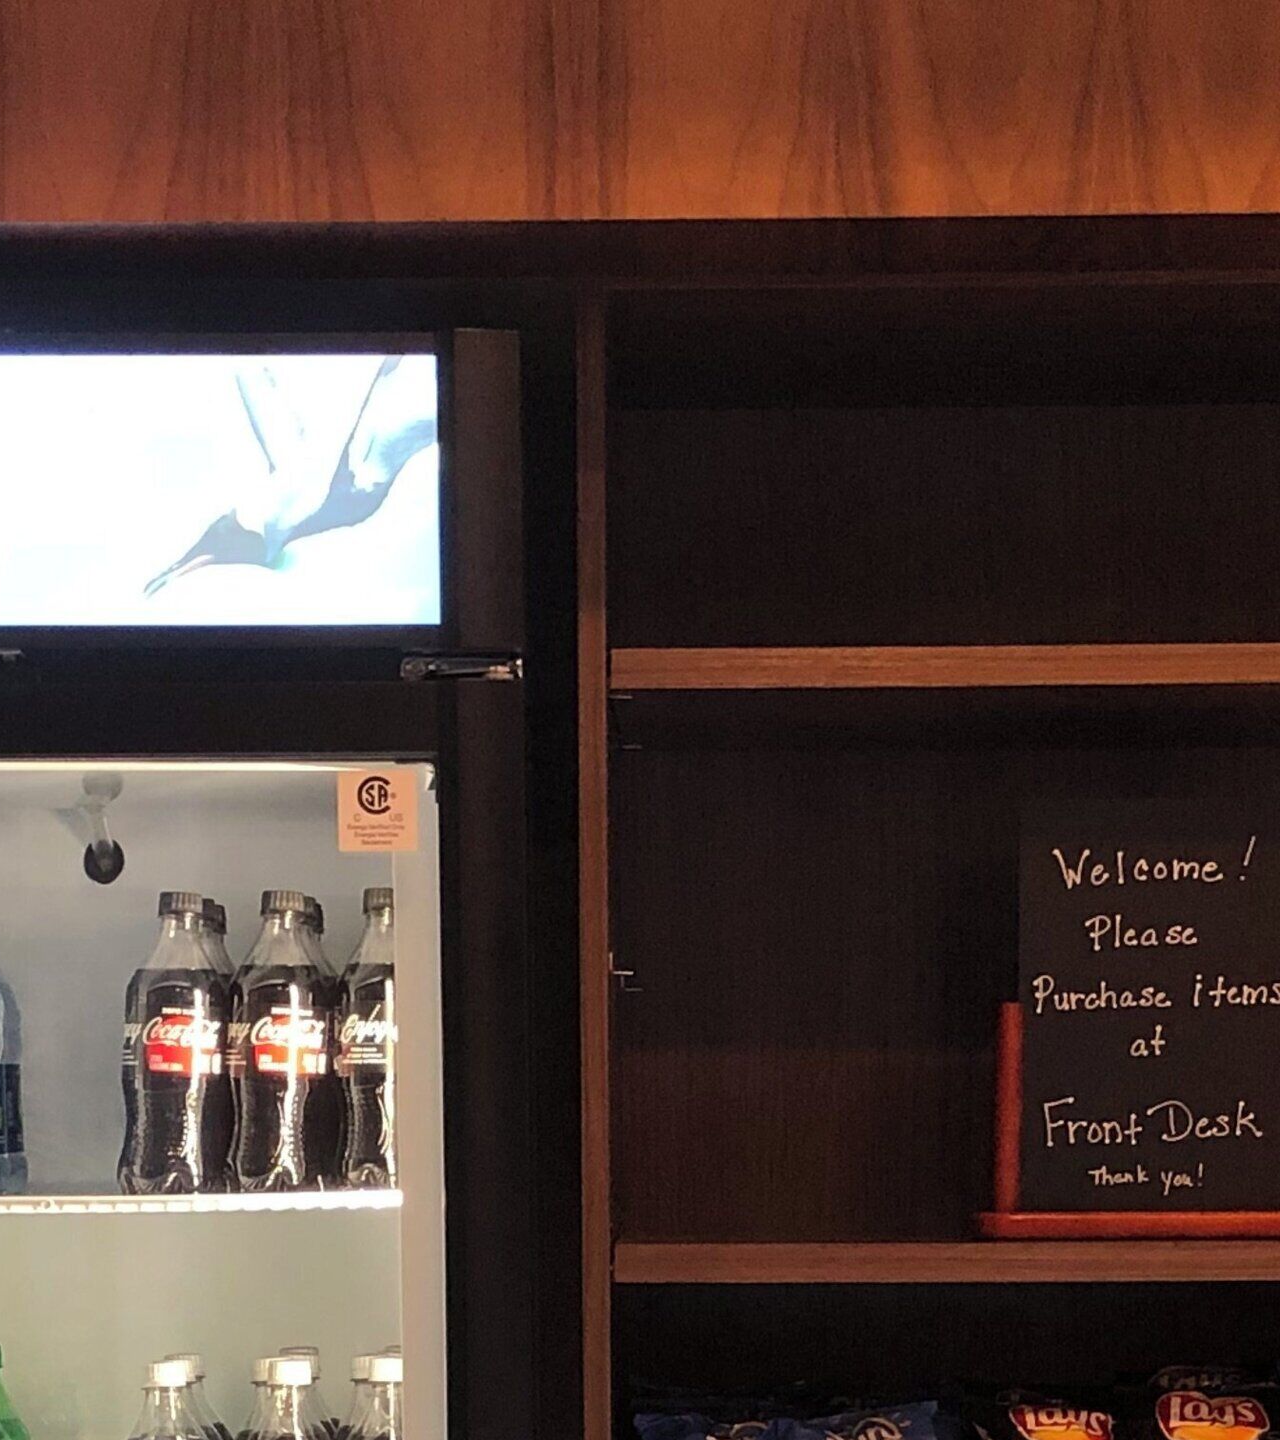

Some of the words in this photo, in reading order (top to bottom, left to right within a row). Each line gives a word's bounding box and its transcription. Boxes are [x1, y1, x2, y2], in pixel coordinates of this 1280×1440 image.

[1083, 914, 1199, 952] Please
[1031, 974, 1173, 1015] Purchase
[1129, 1024, 1167, 1058] at
[1042, 1096, 1144, 1148] Front
[1145, 1099, 1264, 1143] Desk
[1087, 1163, 1150, 1187] Thank
[1160, 1162, 1205, 1196] you!
